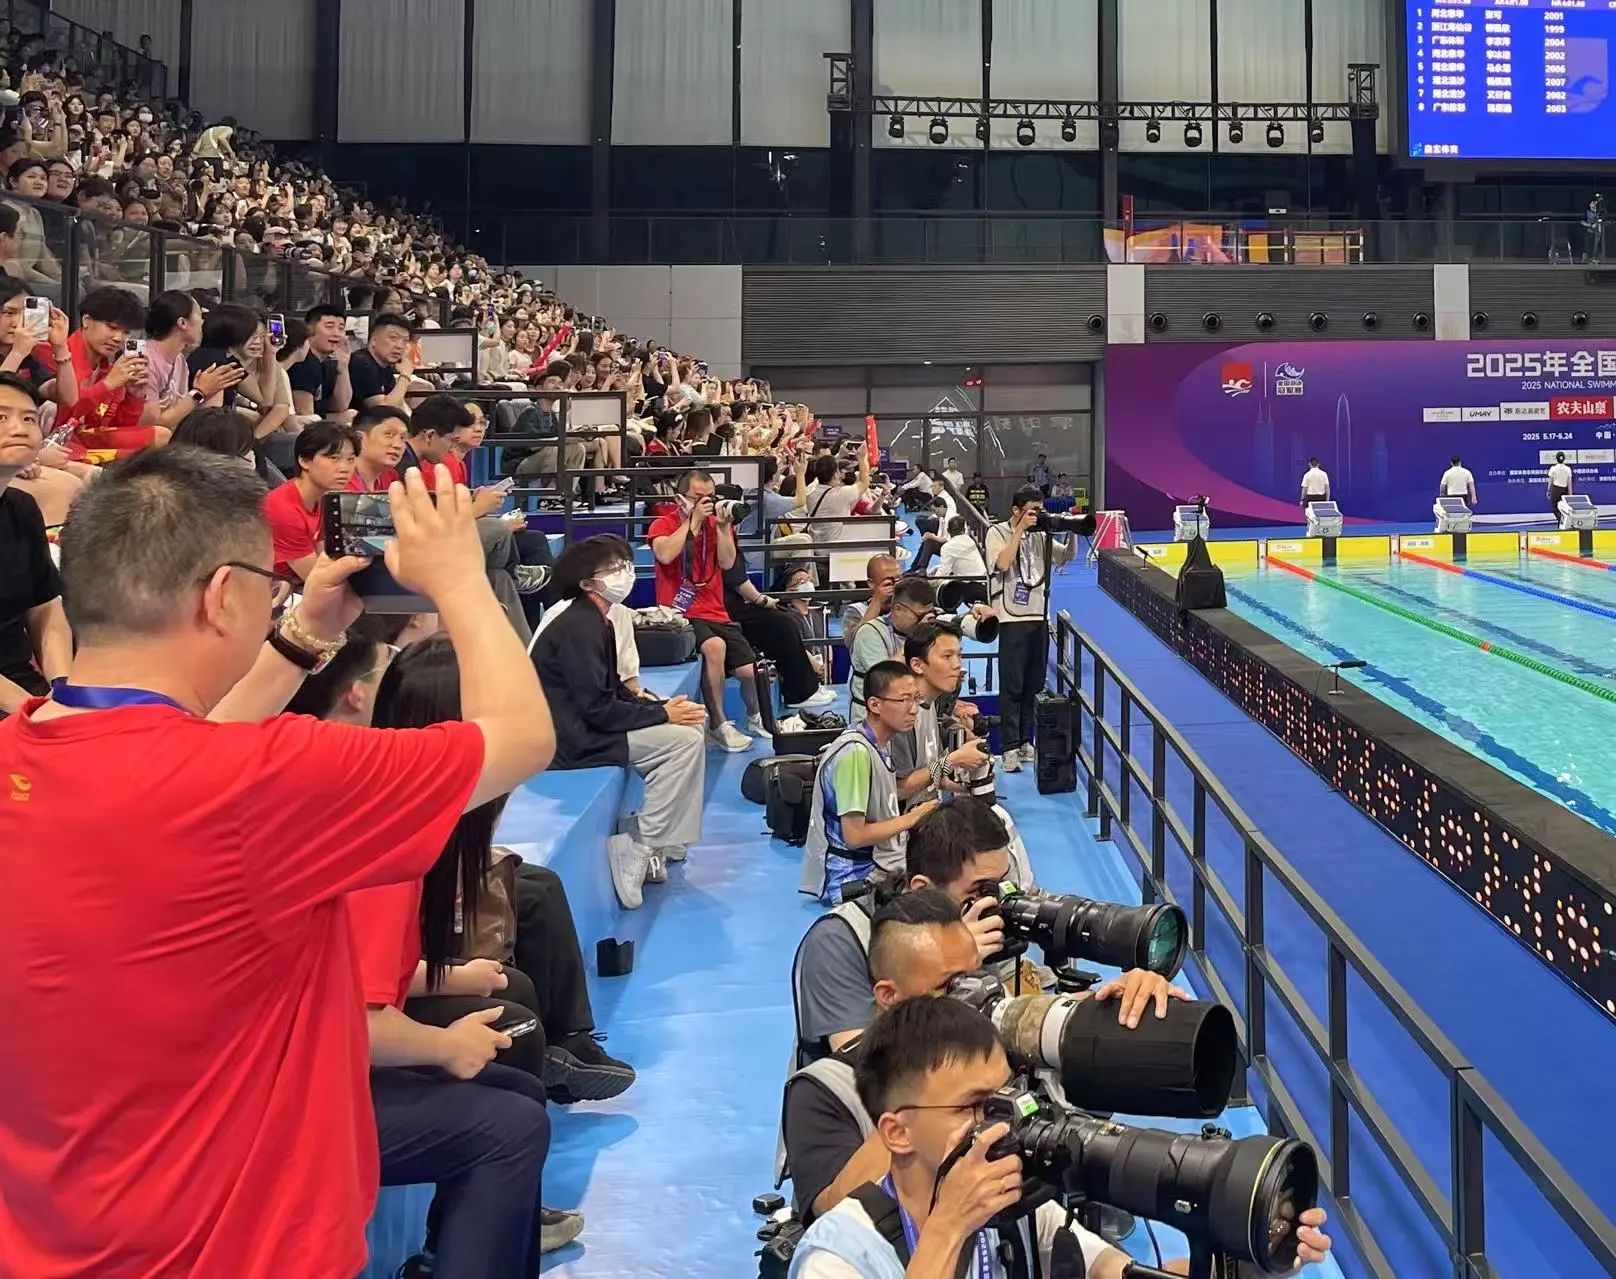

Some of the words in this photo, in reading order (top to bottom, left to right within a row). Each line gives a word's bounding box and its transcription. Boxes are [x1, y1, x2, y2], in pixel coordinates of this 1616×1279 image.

[1417, 8, 1422, 17] 1
[1543, 11, 1564, 20] 2001
[1416, 21, 1423, 30] 2
[1544, 25, 1565, 33] 1999
[1417, 35, 1424, 44] 3
[1544, 38, 1566, 46] 2004
[1416, 48, 1424, 57] 4
[1544, 52, 1566, 60] 2002
[1417, 62, 1424, 71] 5
[1545, 65, 1566, 73] 2006
[1417, 75, 1424, 84] 6
[1545, 78, 1566, 86] 2007
[1418, 89, 1425, 98] 7
[1545, 91, 1567, 100] 2002
[1418, 102, 1425, 112] 8
[1546, 105, 1567, 113] 2003
[1466, 350, 1616, 377] 2025年全国
[1521, 381, 1542, 390] 2025
[1544, 380, 1586, 389] NATIONAL
[1556, 401, 1607, 415] 农夫山泉
[1522, 432, 1541, 441] 2025
